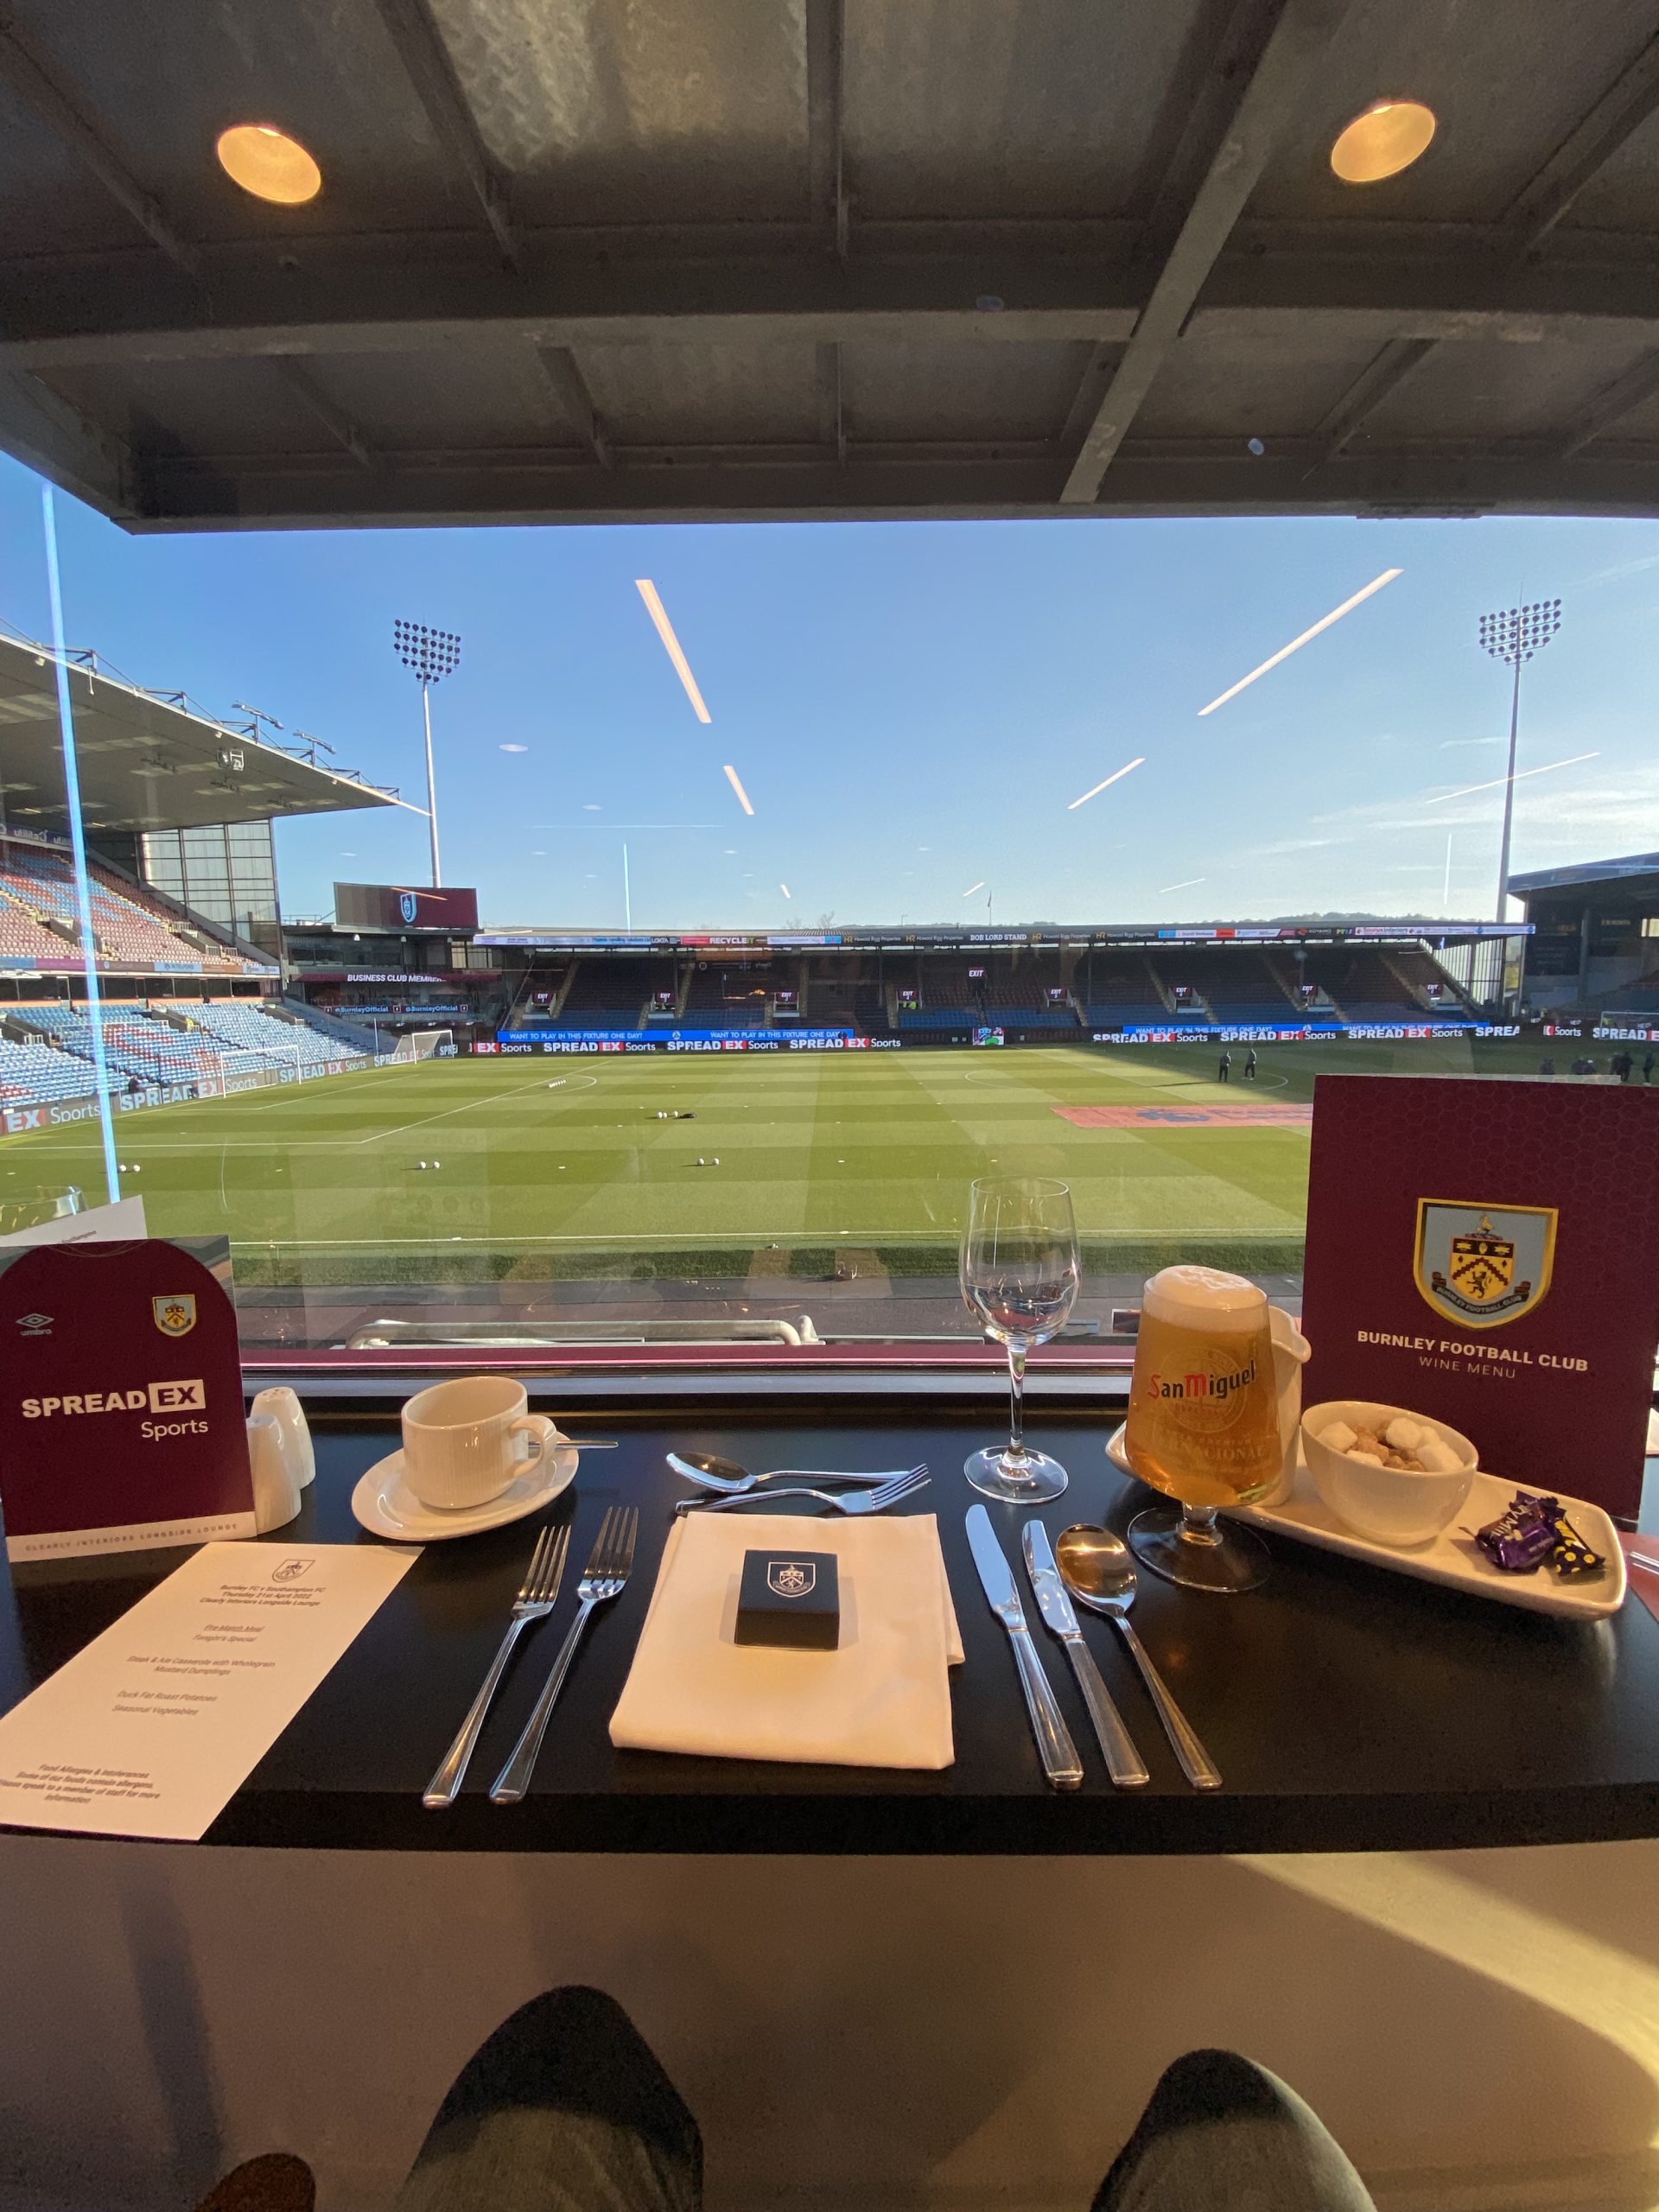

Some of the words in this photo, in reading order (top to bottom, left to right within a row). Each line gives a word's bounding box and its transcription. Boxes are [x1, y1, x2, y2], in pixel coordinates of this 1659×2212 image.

[346, 974, 386, 982] BUSINESS
[386, 974, 408, 982] CLUB
[1304, 1030, 1336, 1040] Sports
[1432, 1027, 1463, 1038] Sports
[1554, 1026, 1581, 1037] Sports
[871, 1038, 901, 1048] Sports
[1176, 1033, 1208, 1042] Sports
[501, 1042, 532, 1053] Sports
[626, 1041, 656, 1052] Sports
[748, 1039, 779, 1050] Sports
[345, 1059, 366, 1072] Sports
[226, 1077, 257, 1092] Sports
[50, 1103, 101, 1125] Sports
[20, 1327, 53, 1337] umbro
[1357, 1330, 1436, 1352] BURNLEY
[1440, 1340, 1534, 1364] FOOTBALL
[1538, 1354, 1588, 1372] CLUB
[1419, 1356, 1460, 1371] WINE
[1467, 1363, 1516, 1379] MENU
[141, 1419, 208, 1442] Sports
